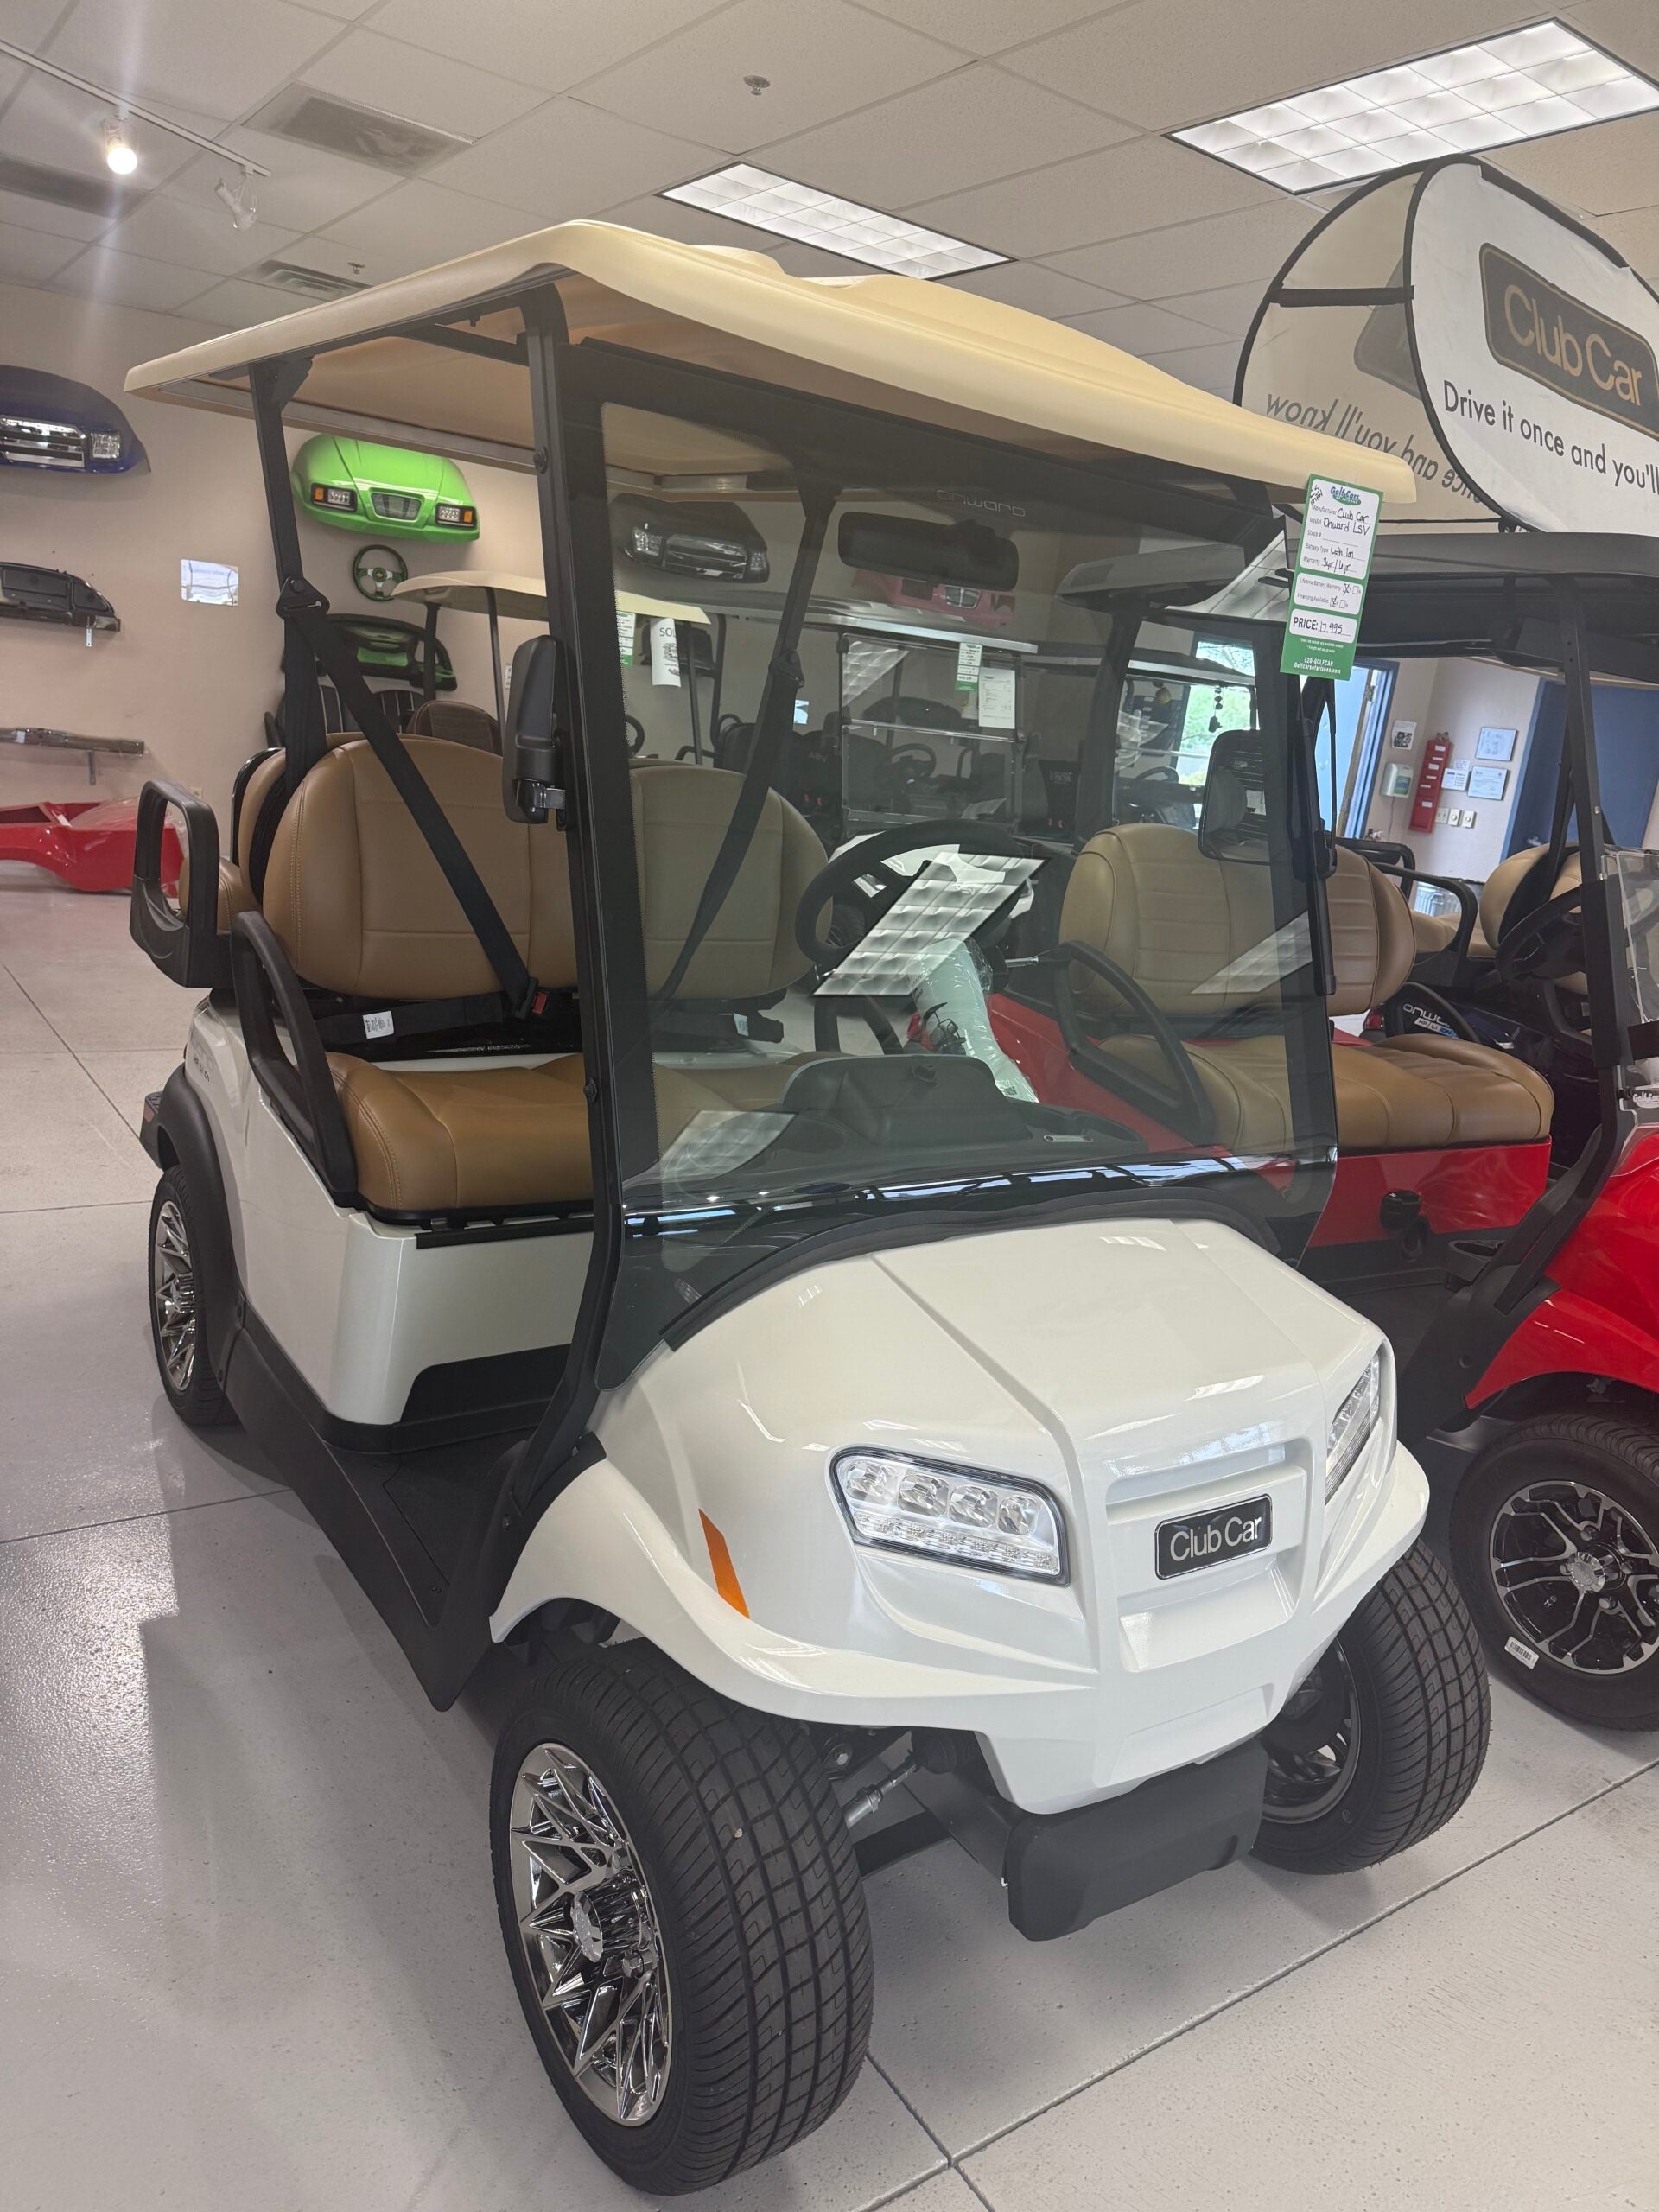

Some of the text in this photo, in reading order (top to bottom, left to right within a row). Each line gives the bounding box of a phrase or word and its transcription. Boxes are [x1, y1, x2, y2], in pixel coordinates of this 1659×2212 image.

[1504, 284, 1642, 406] Club Car
[1444, 380, 1659, 496] Drive it once and you'll
[1331, 486, 1360, 500] Golf Cars
[1337, 507, 1354, 521] Club
[1356, 512, 1369, 523] Car
[1324, 518, 1350, 532] Onward
[1353, 522, 1371, 536] LSV
[1305, 543, 1319, 551] Battery
[1293, 616, 1319, 631] PRICE:
[1170, 1516, 1262, 1561] Club Car
